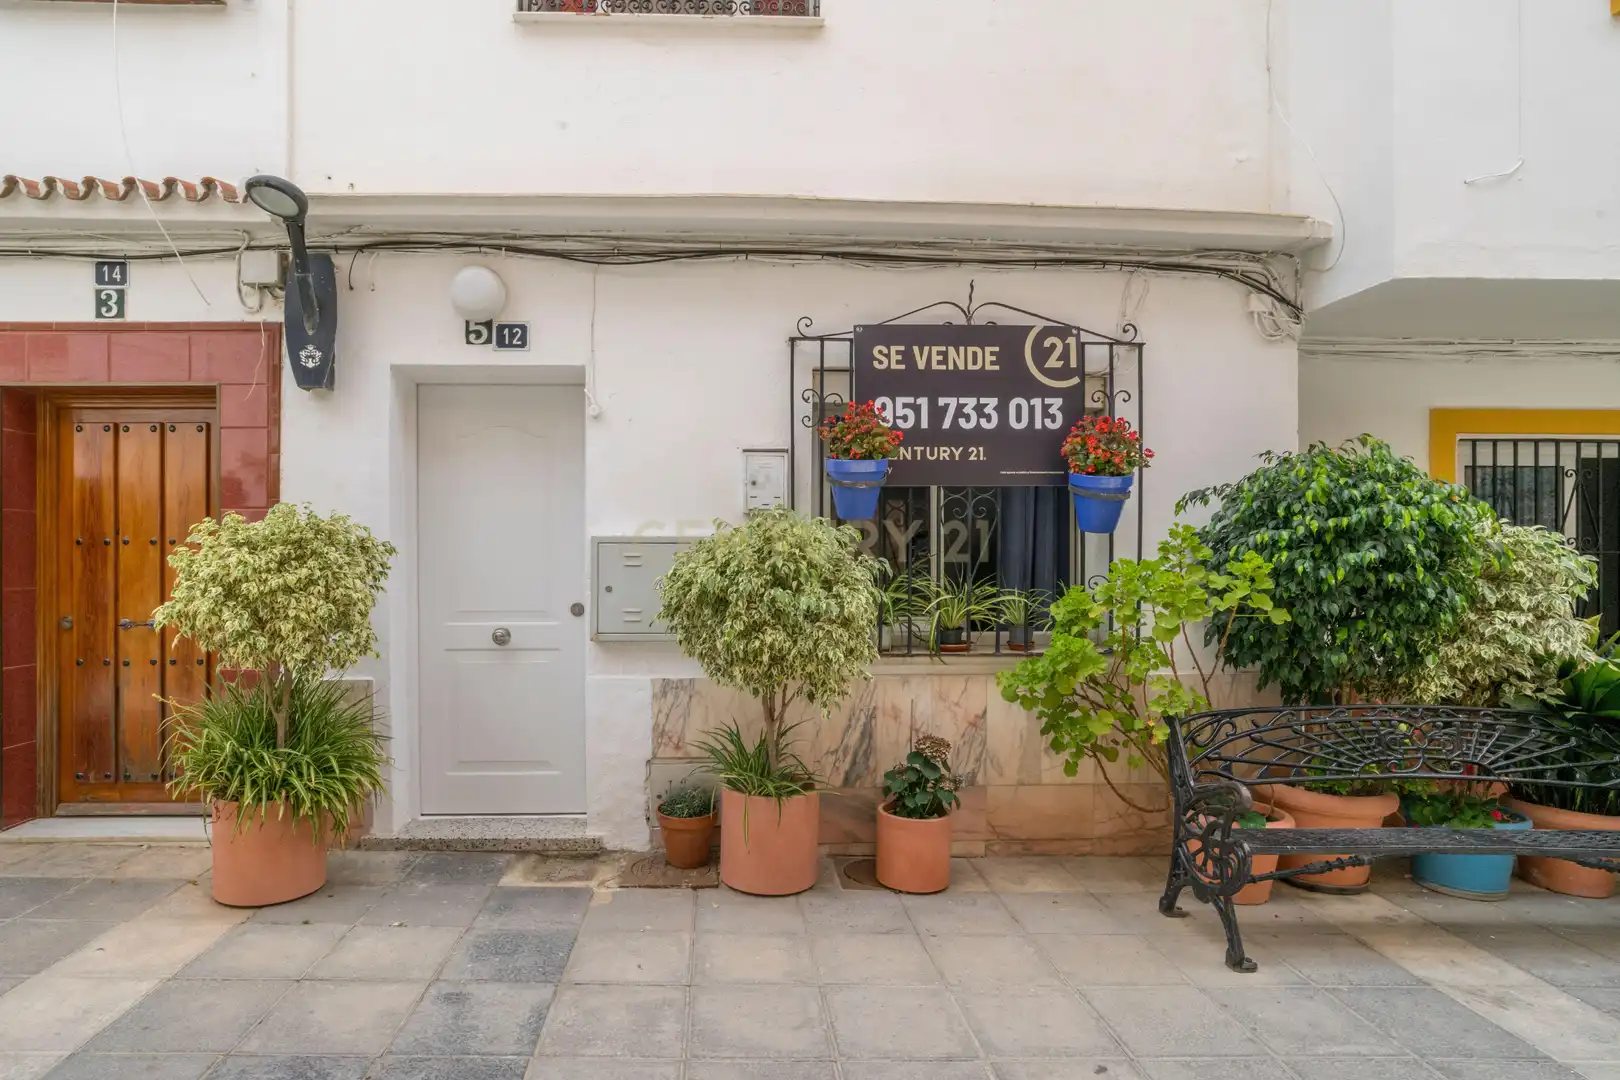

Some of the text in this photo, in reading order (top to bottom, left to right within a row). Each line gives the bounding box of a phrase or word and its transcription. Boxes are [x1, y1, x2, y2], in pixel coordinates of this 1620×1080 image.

[102, 265, 122, 282] 14
[100, 290, 118, 317] 3
[468, 320, 488, 344] 5
[503, 327, 522, 345] 12
[872, 345, 1000, 371] SE VENDE
[874, 396, 1064, 430] 951 733 013
[888, 446, 964, 461] NTURY
